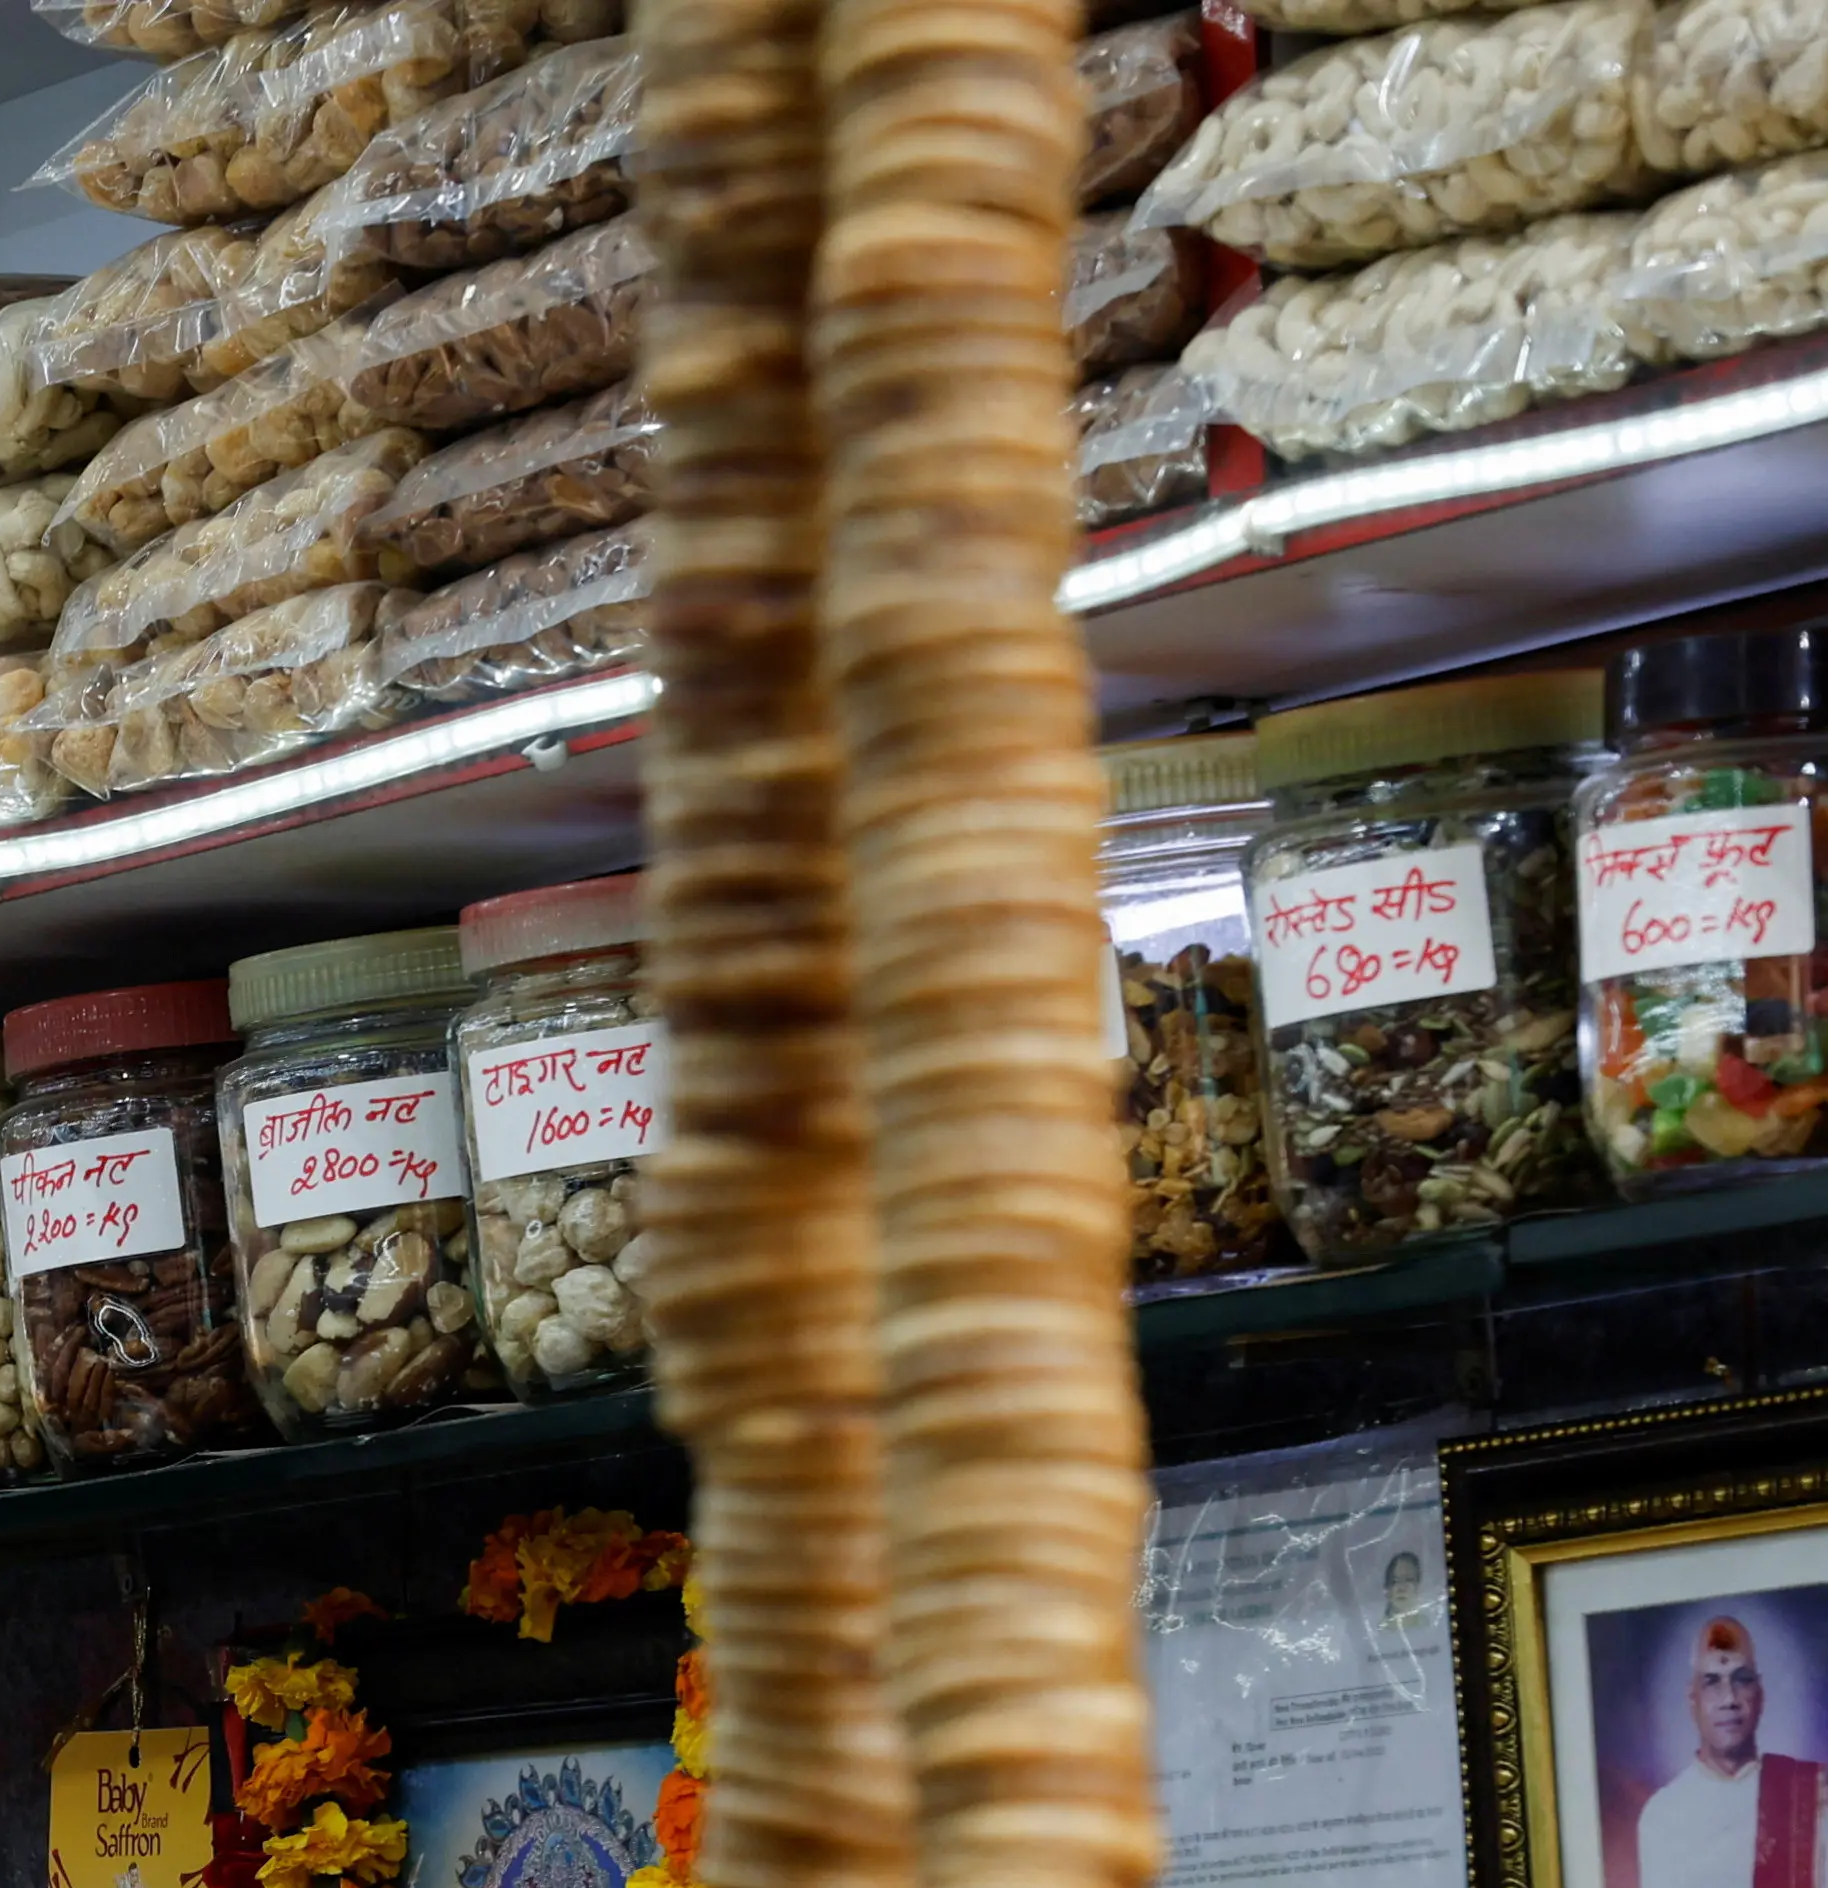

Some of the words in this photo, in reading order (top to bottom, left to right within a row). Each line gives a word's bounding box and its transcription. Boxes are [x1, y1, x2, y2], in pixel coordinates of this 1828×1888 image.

[96, 1768, 147, 1826] Baby
[141, 1812, 169, 1829] Brand
[94, 1822, 161, 1858] Saffron
